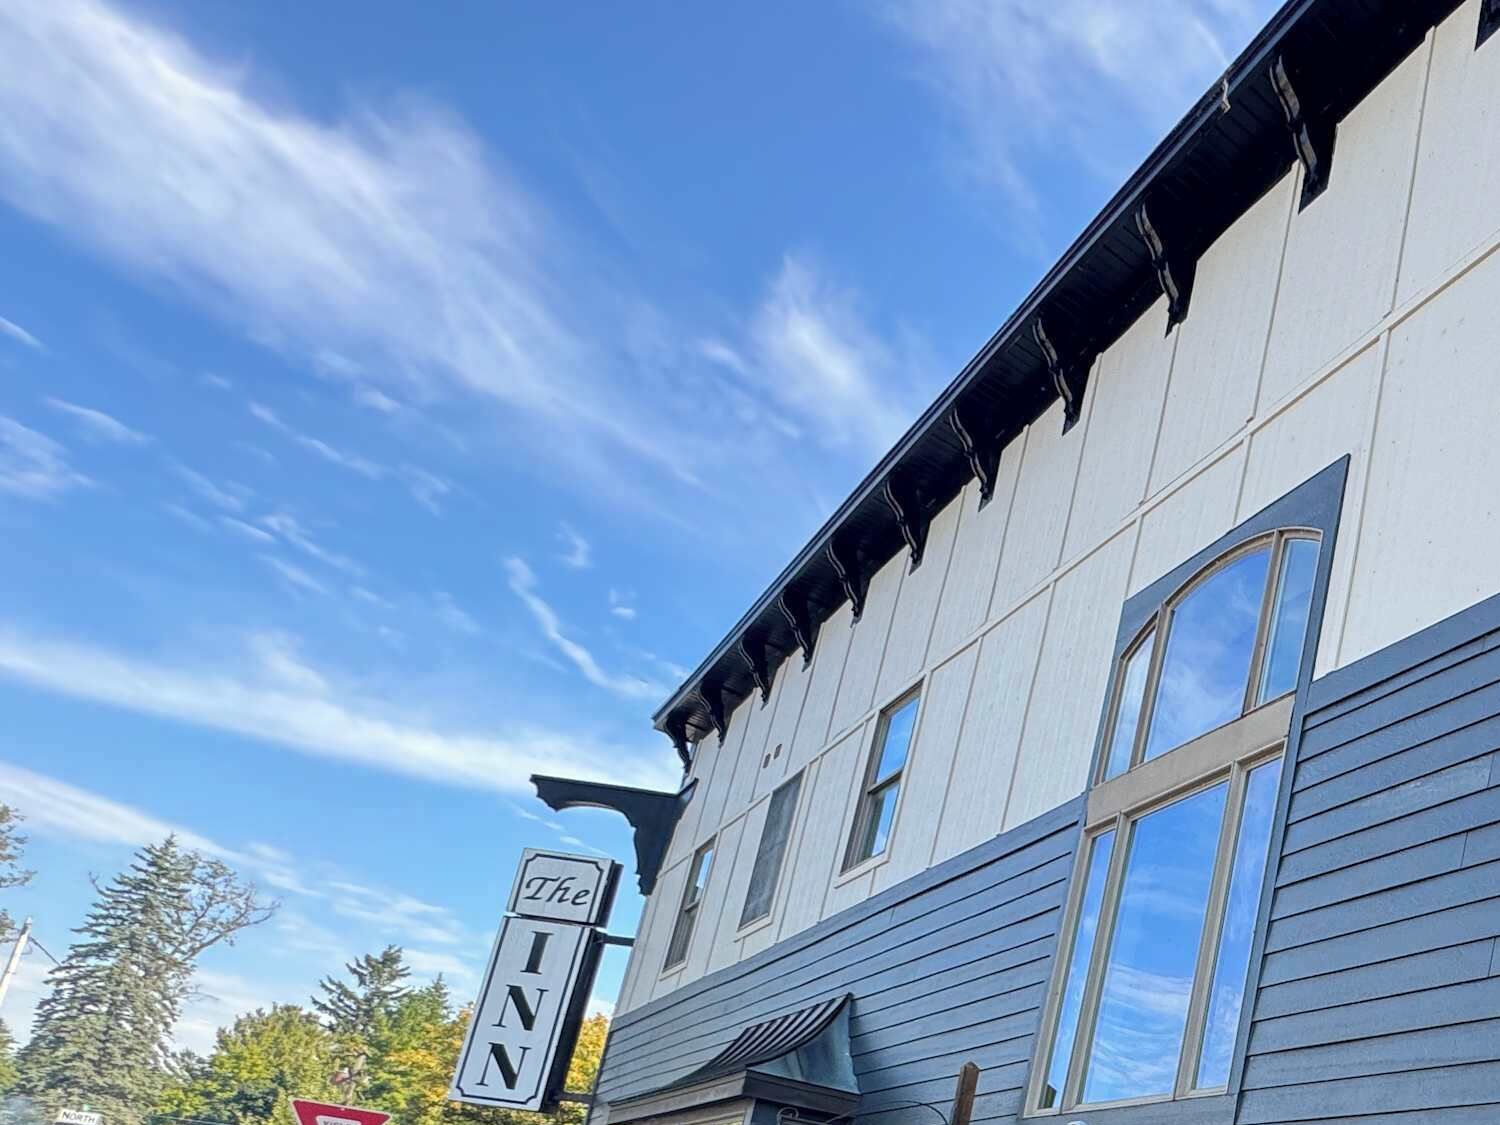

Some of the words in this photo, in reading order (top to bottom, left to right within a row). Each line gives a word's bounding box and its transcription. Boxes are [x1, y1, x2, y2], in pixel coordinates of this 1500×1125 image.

[523, 875, 591, 906] The
[475, 930, 554, 1091] INN
[62, 1111, 96, 1123] NORTH
